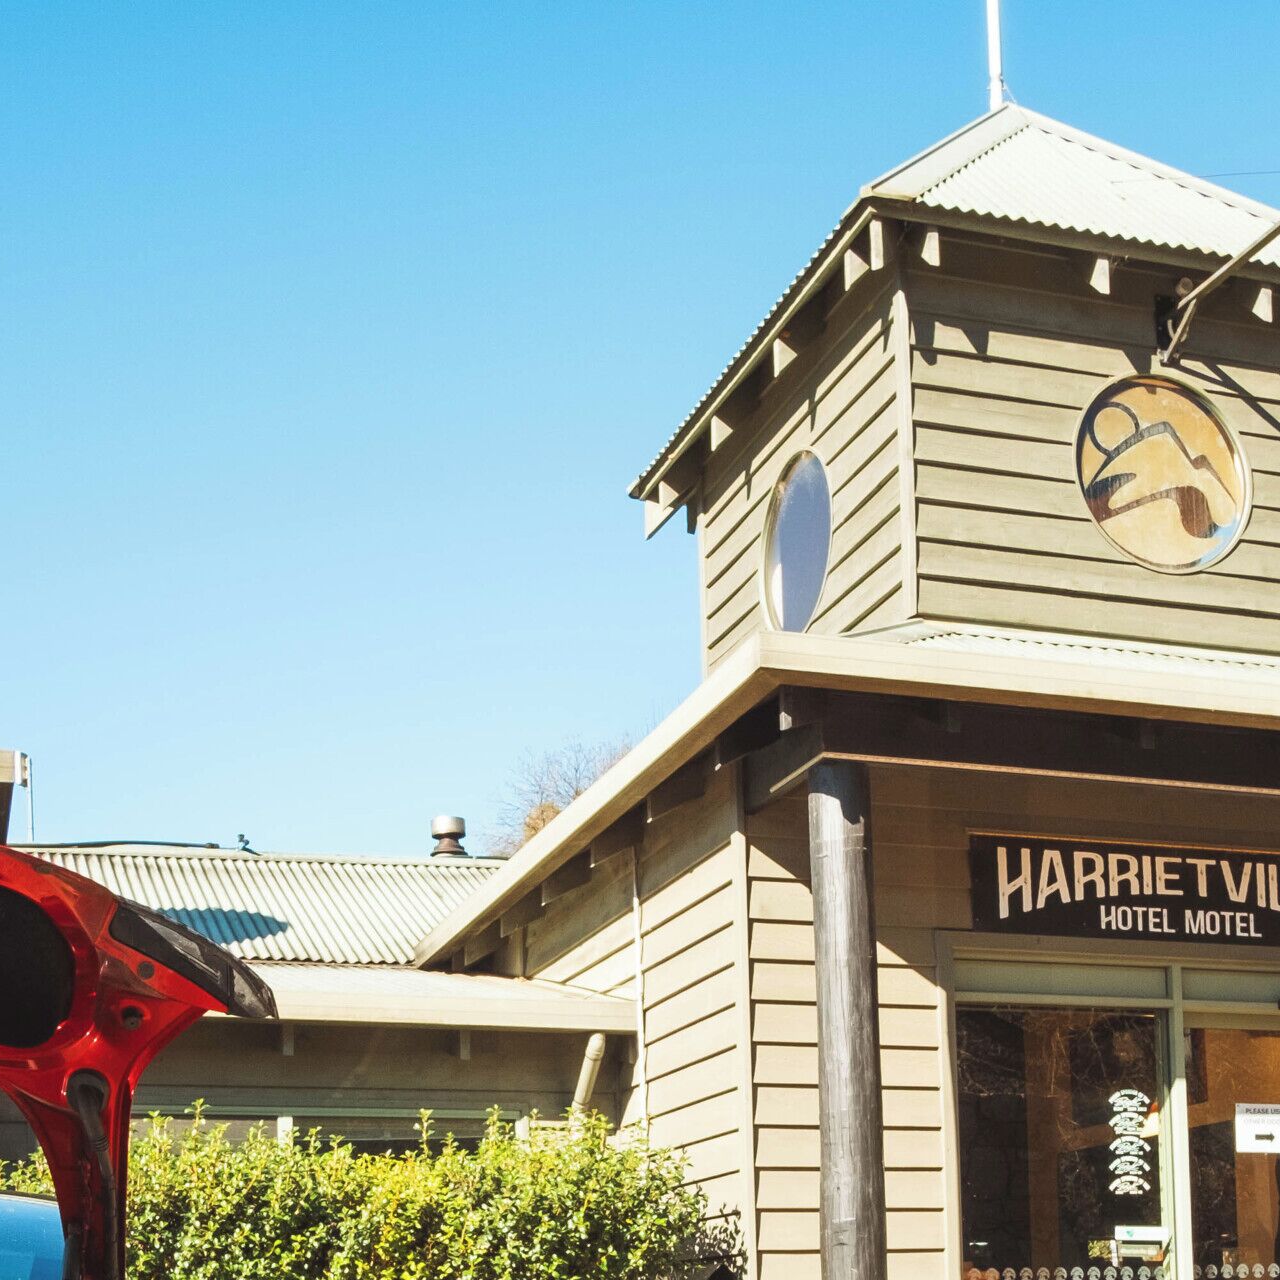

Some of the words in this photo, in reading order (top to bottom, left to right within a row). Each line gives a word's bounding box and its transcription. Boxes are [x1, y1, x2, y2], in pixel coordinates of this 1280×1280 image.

[1100, 904, 1176, 934] HOTEL
[1185, 909, 1263, 938] MOTEL
[1245, 1107, 1270, 1115] PLEASE
